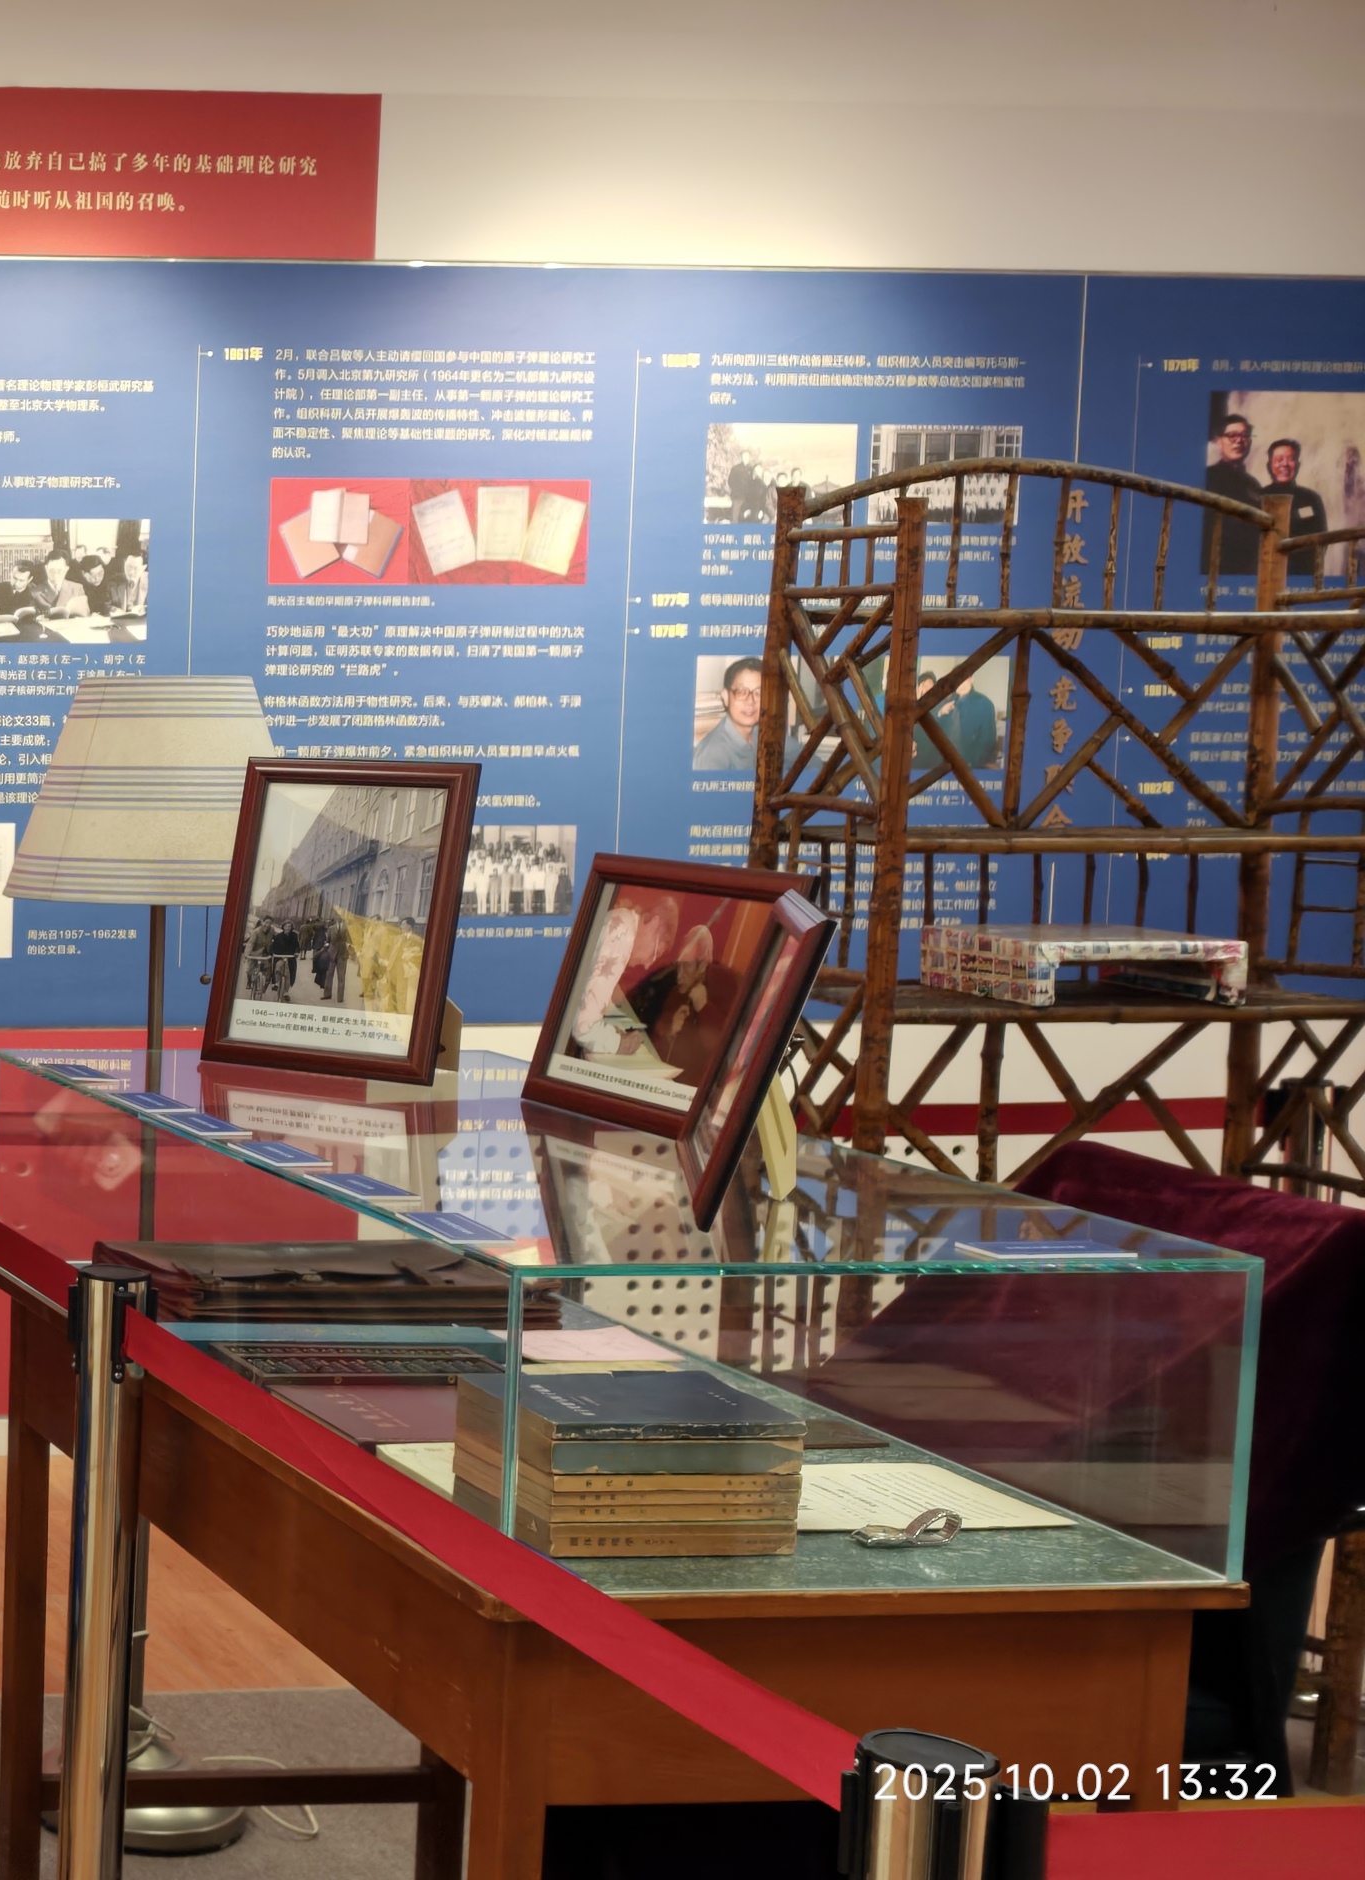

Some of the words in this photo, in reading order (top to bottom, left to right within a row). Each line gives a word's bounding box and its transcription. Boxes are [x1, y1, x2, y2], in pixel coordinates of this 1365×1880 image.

[271, 446, 312, 459] 的认识。
[27, 944, 82, 956] 的论文目录。
